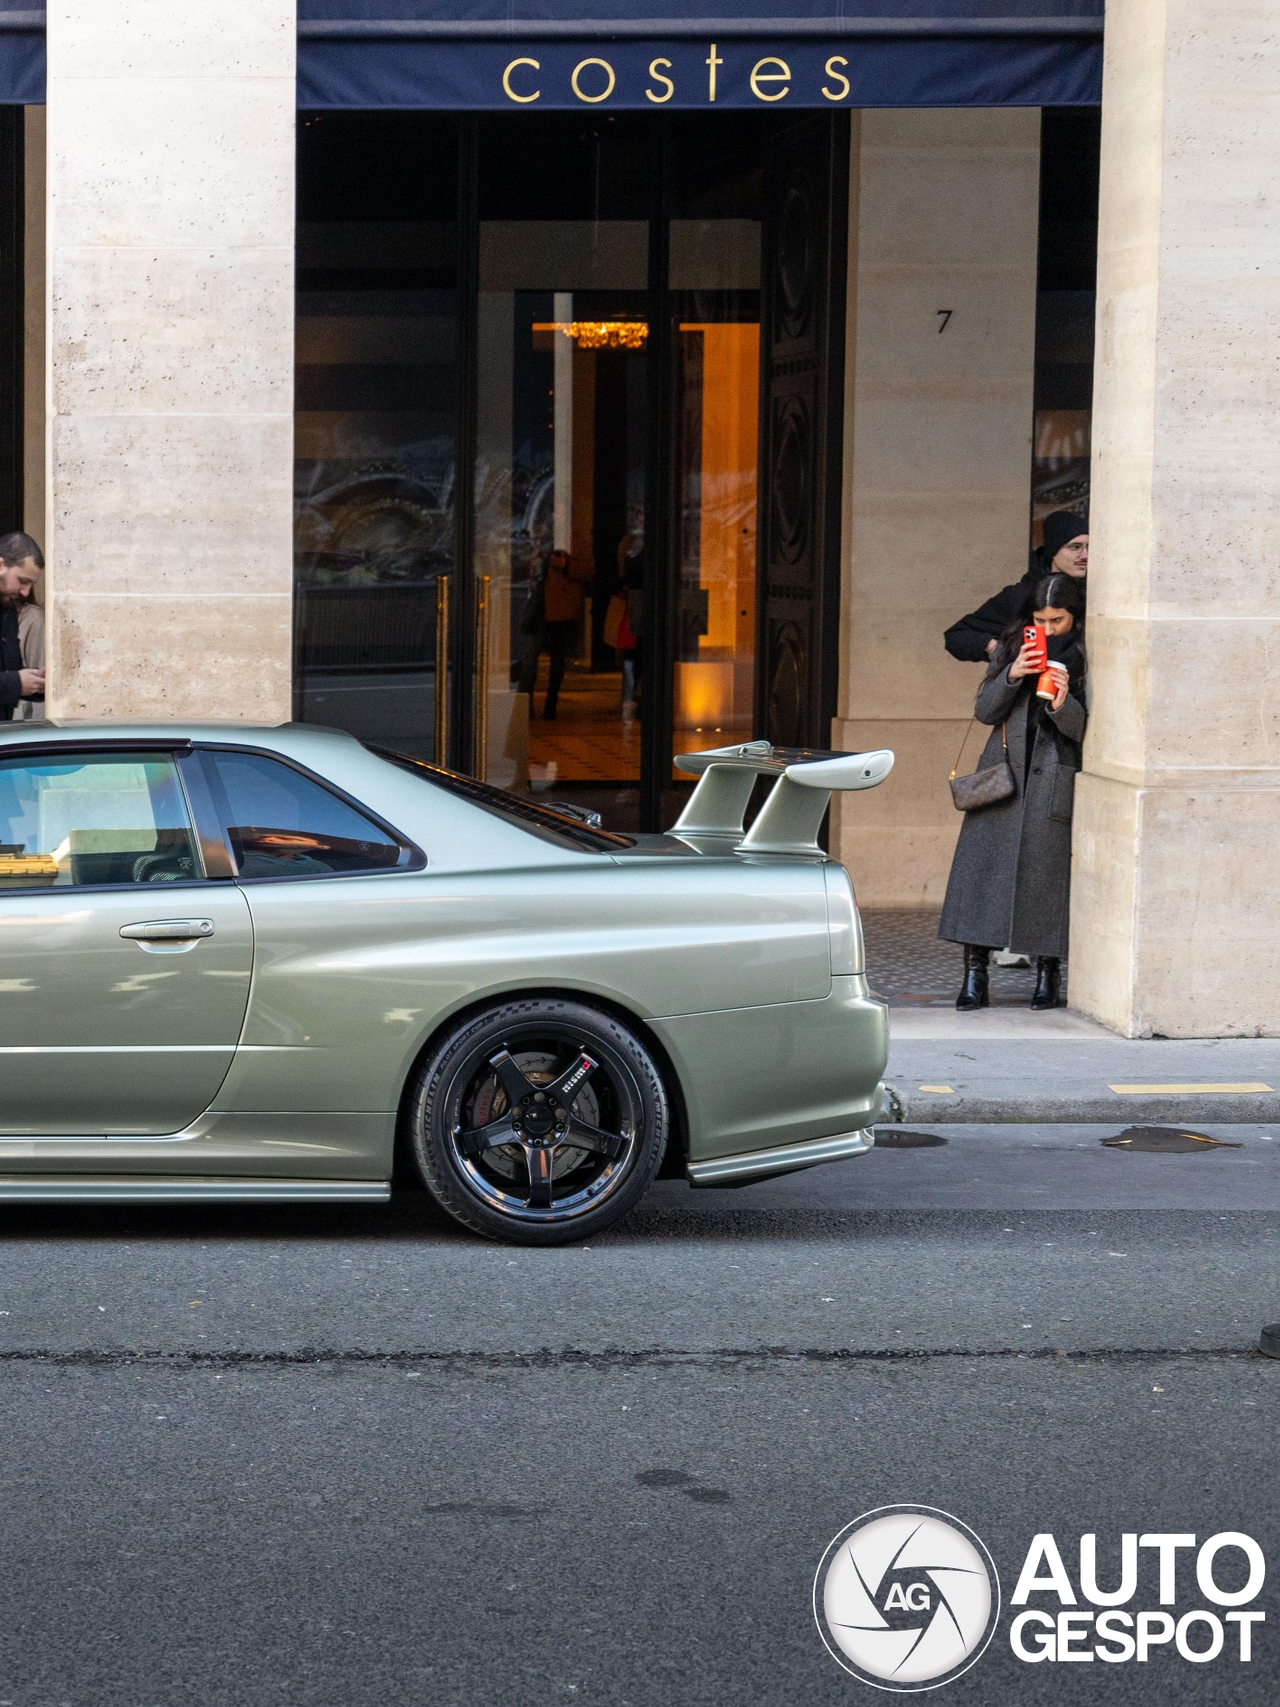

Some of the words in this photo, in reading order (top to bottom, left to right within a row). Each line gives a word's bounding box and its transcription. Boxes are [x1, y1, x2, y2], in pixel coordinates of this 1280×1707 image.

[502, 43, 851, 104] costes
[936, 309, 953, 334] 7
[425, 1072, 441, 1141] MICHELIN
